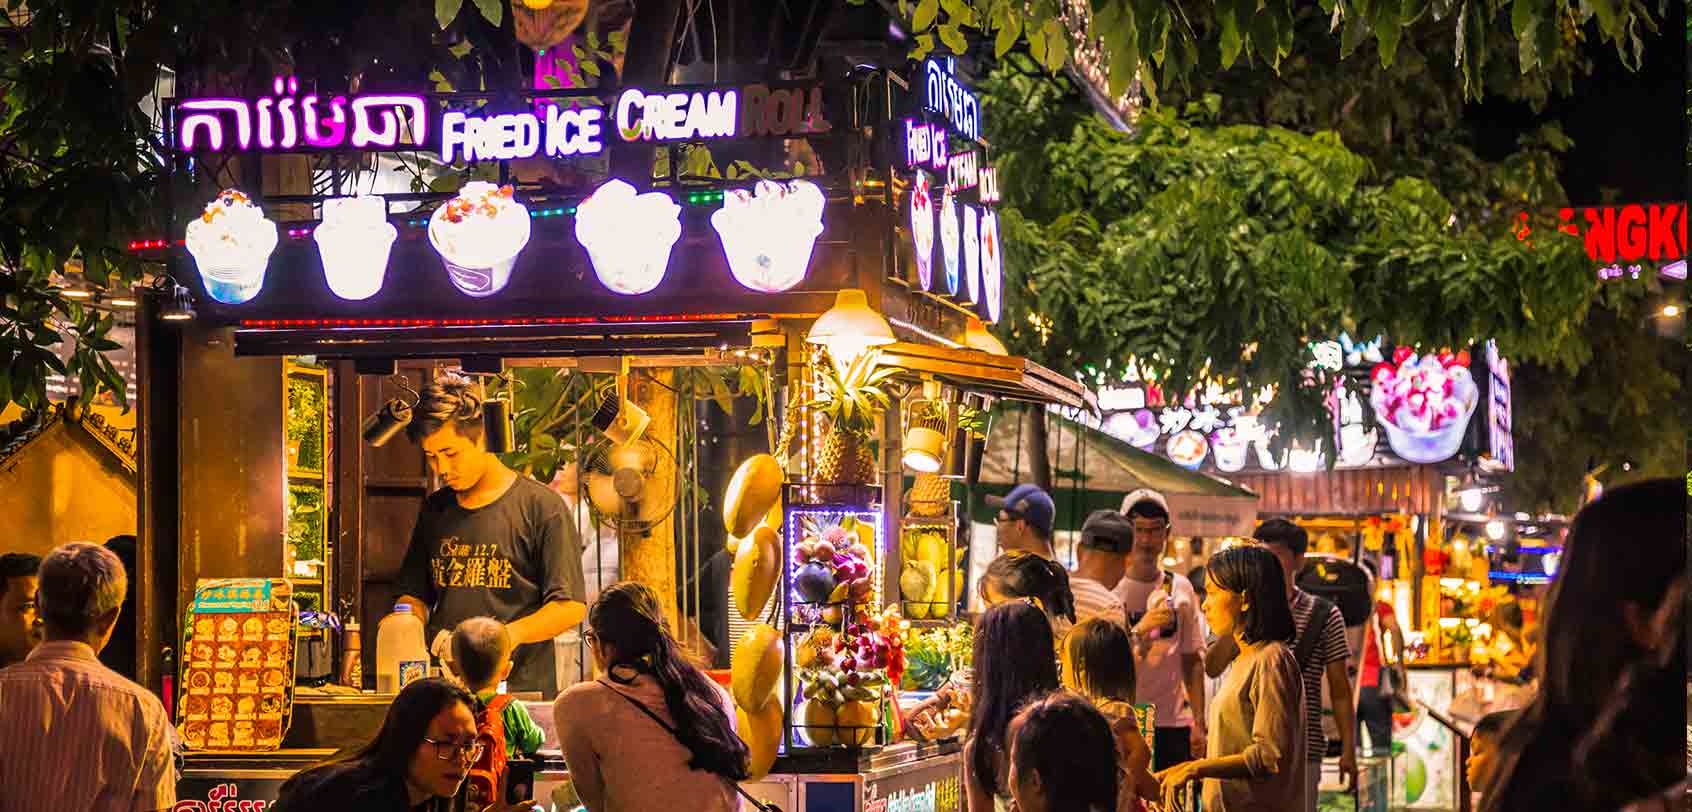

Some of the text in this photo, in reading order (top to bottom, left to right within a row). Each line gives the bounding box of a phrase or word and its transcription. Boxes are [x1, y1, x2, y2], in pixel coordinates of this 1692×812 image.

[442, 87, 833, 164] FRIED ICE CREAM ROLL
[906, 119, 947, 169] FRIED ICE
[979, 167, 999, 203] ROLL
